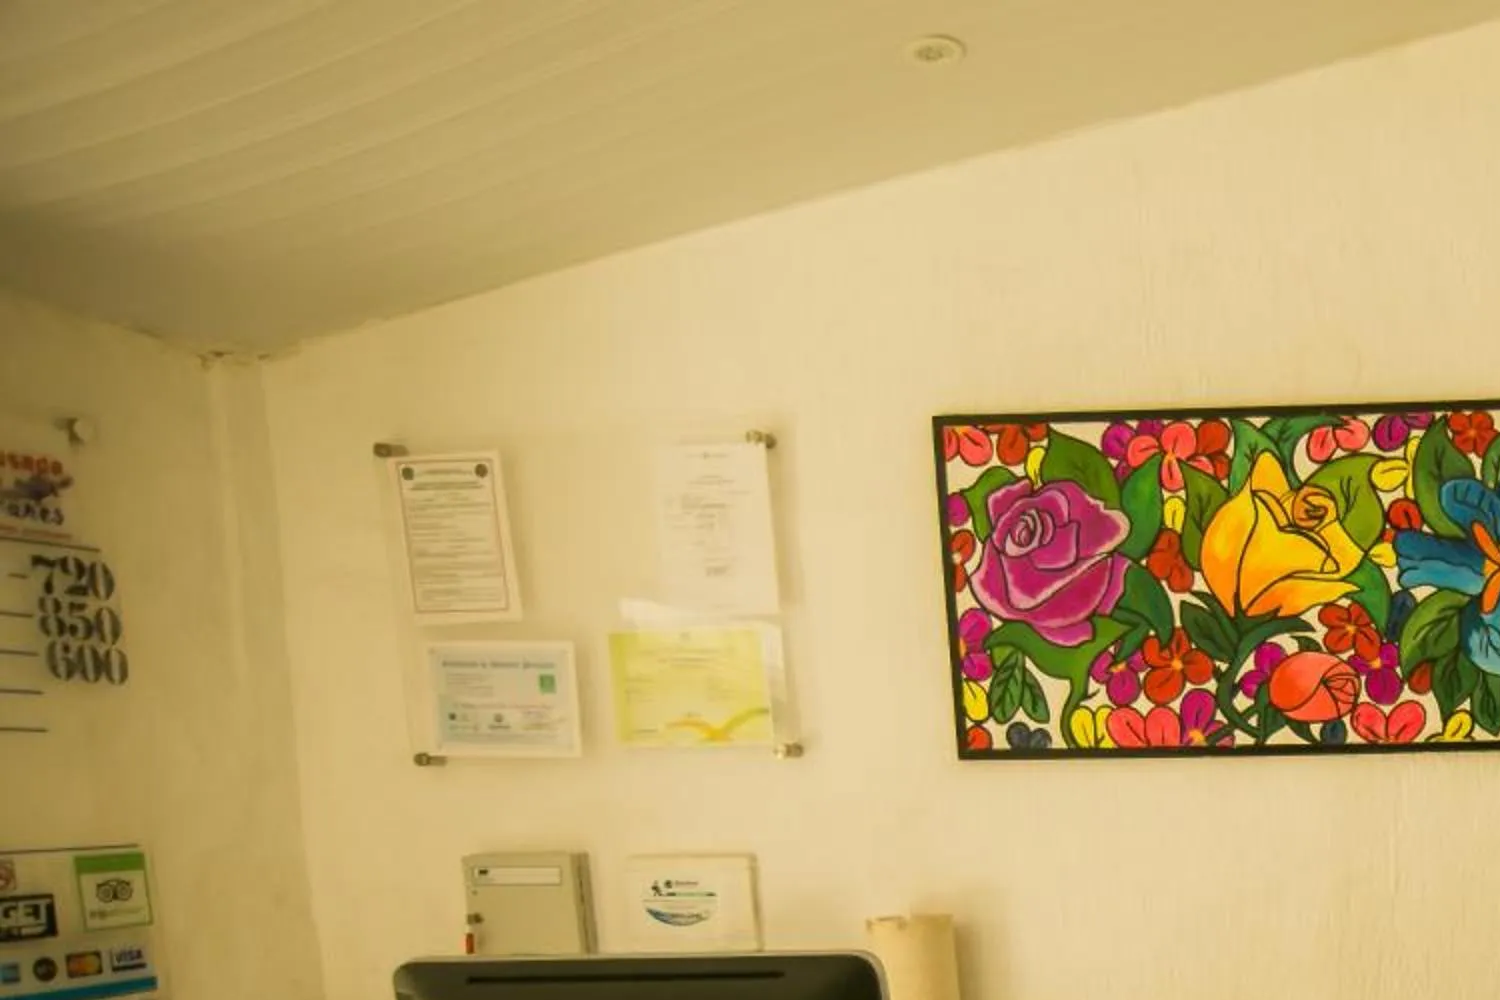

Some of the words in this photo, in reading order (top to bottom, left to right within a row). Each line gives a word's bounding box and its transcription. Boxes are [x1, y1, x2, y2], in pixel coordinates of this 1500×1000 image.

[31, 555, 115, 600] 720
[46, 640, 129, 685] 600
[115, 949, 143, 964] VISA
